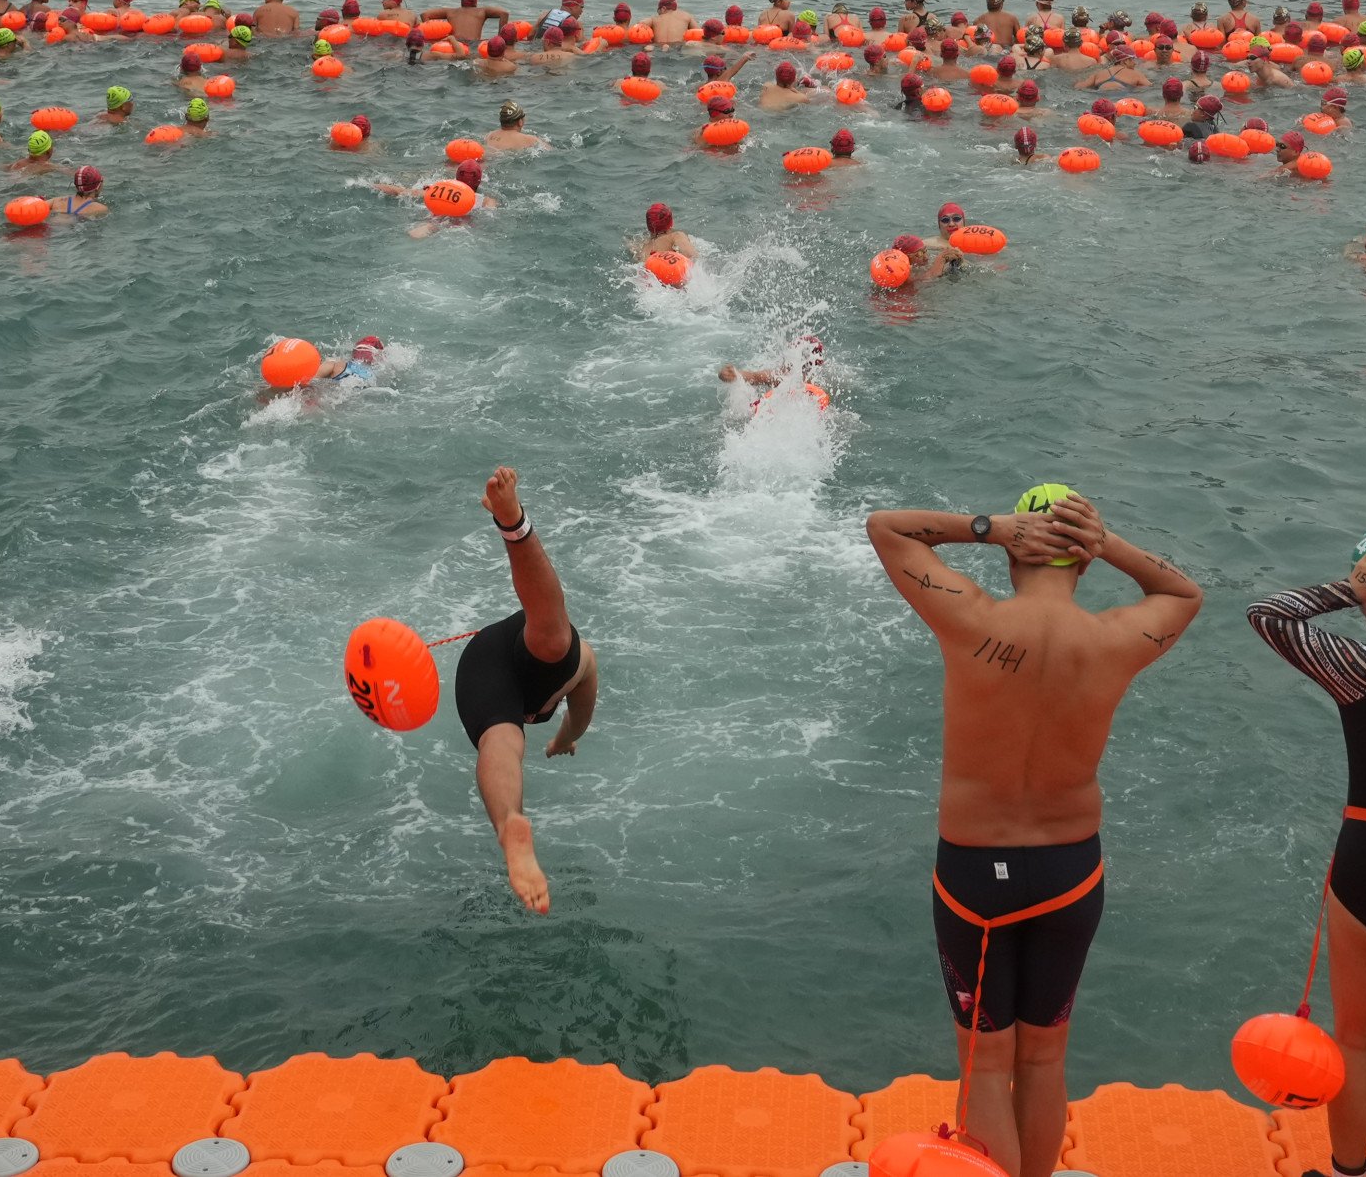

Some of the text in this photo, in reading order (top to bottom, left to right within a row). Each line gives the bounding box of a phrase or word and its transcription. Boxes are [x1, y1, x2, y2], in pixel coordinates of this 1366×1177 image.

[793, 148, 822, 157] 2251
[430, 184, 462, 204] 2116
[963, 226, 995, 237] 2084
[974, 637, 1027, 673] 1141
